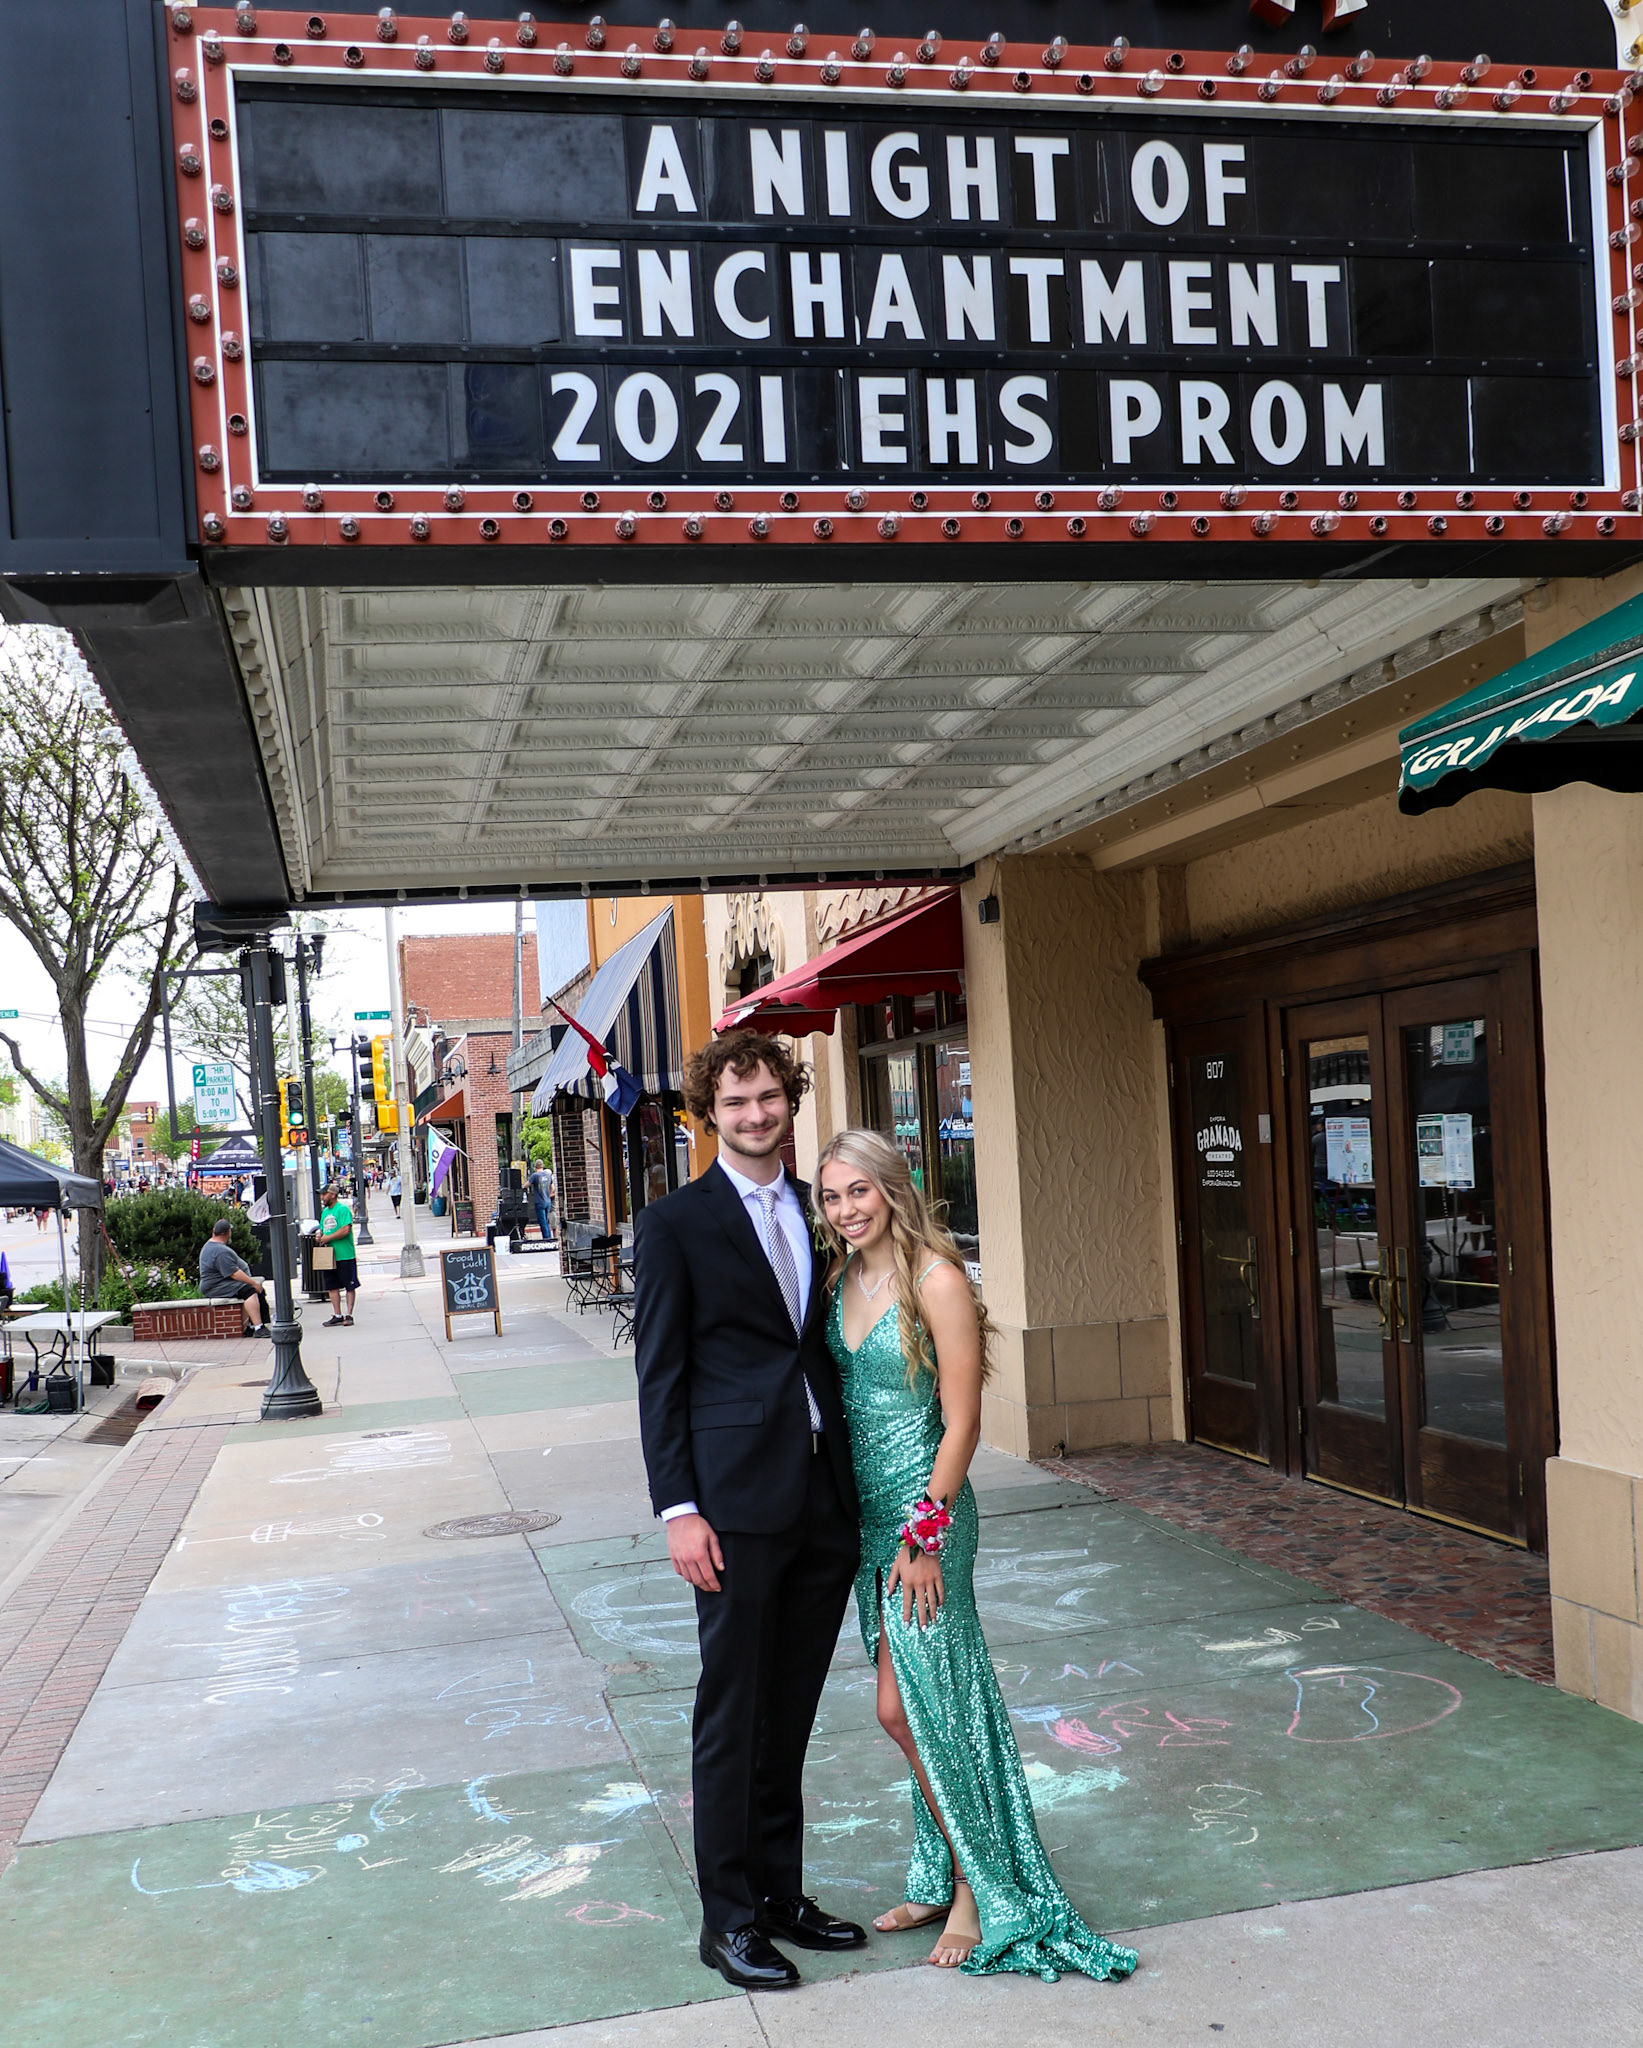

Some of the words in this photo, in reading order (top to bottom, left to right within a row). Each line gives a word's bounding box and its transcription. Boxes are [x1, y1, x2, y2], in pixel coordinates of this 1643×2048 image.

[636, 125, 698, 212] A
[749, 129, 1070, 222] NIGHT
[1131, 140, 1246, 226] OF
[570, 248, 1341, 348] ENCHANTMENT
[551, 372, 786, 463] 2021
[858, 375, 1053, 464] EHS
[1109, 380, 1385, 466] PROM
[194, 1068, 205, 1084] 2
[1206, 1060, 1224, 1079] 807
[206, 1075, 232, 1084] PARKING
[200, 1088, 216, 1097] 8:00
[217, 1086, 229, 1096] AM
[211, 1097, 220, 1107] TO
[202, 1109, 217, 1119] 5:00
[219, 1108, 230, 1117] PM
[1196, 1124, 1242, 1151] GRANADA
[446, 1251, 474, 1264] Good
